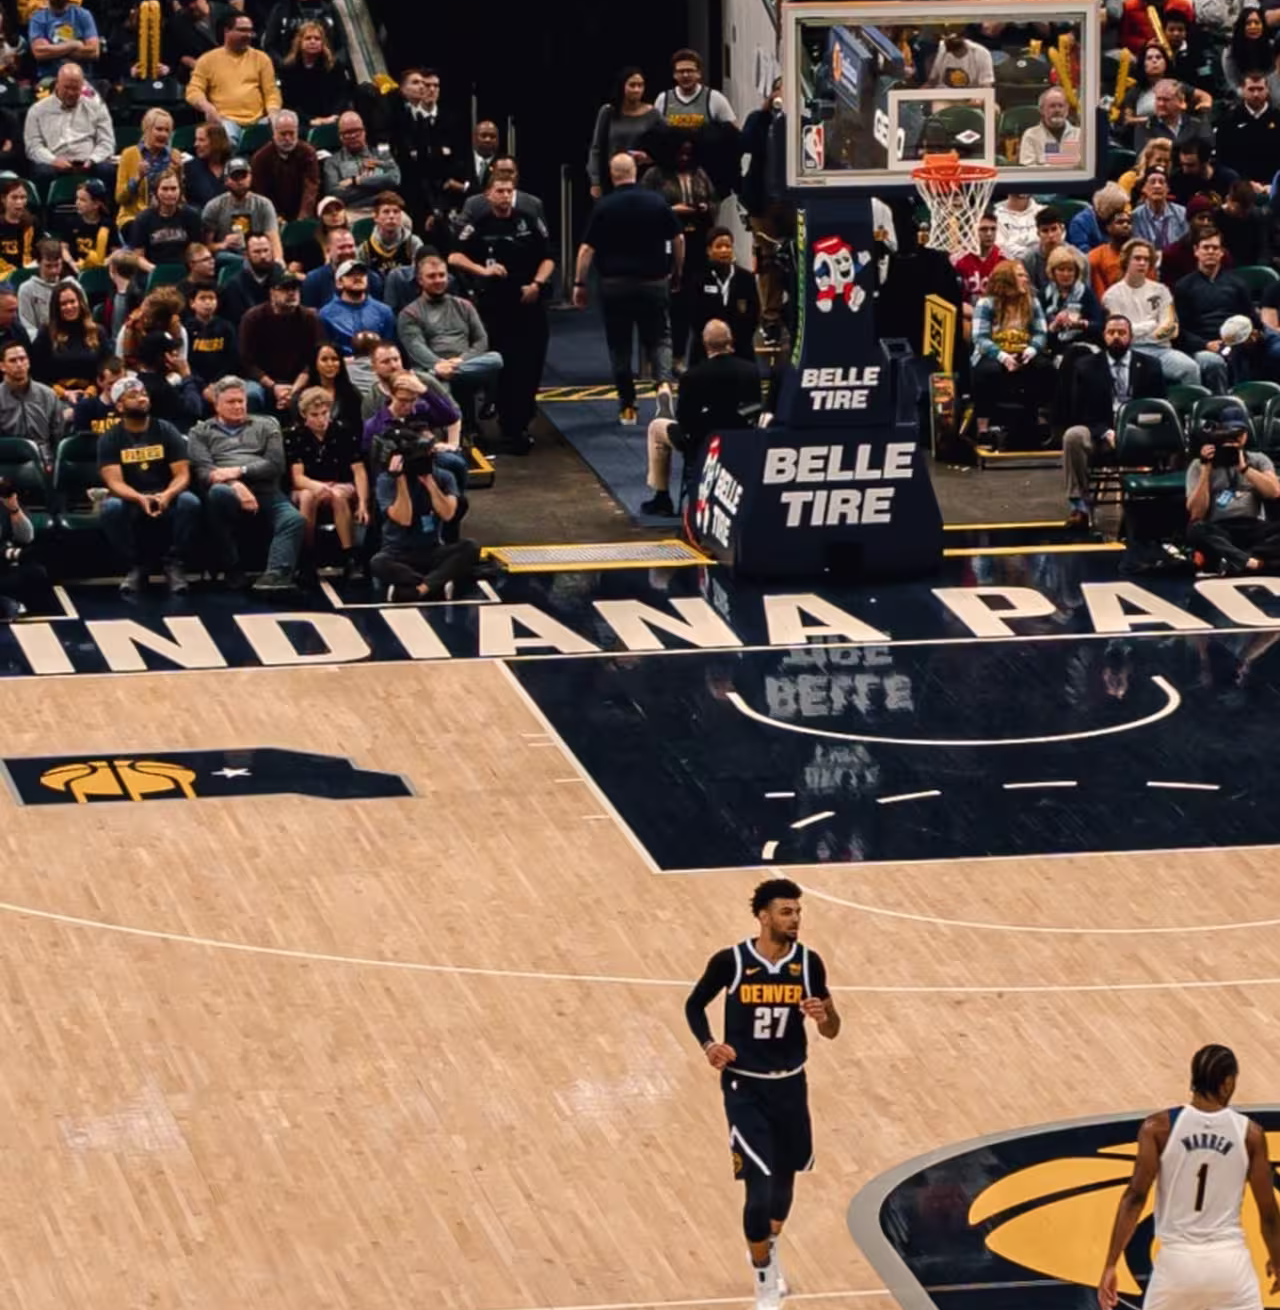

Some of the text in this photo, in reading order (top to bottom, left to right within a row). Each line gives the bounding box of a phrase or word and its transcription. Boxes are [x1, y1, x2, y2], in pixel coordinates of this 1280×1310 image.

[801, 367, 880, 389] BELLE
[810, 390, 869, 411] TIRE
[763, 443, 916, 485] BELLE
[781, 487, 895, 527] TIRE
[9, 593, 891, 675] INDIANA
[739, 983, 803, 1005] DENVER
[753, 1006, 790, 1040] 27
[1180, 1132, 1233, 1156] WARREN
[1194, 1162, 1209, 1213] 1
